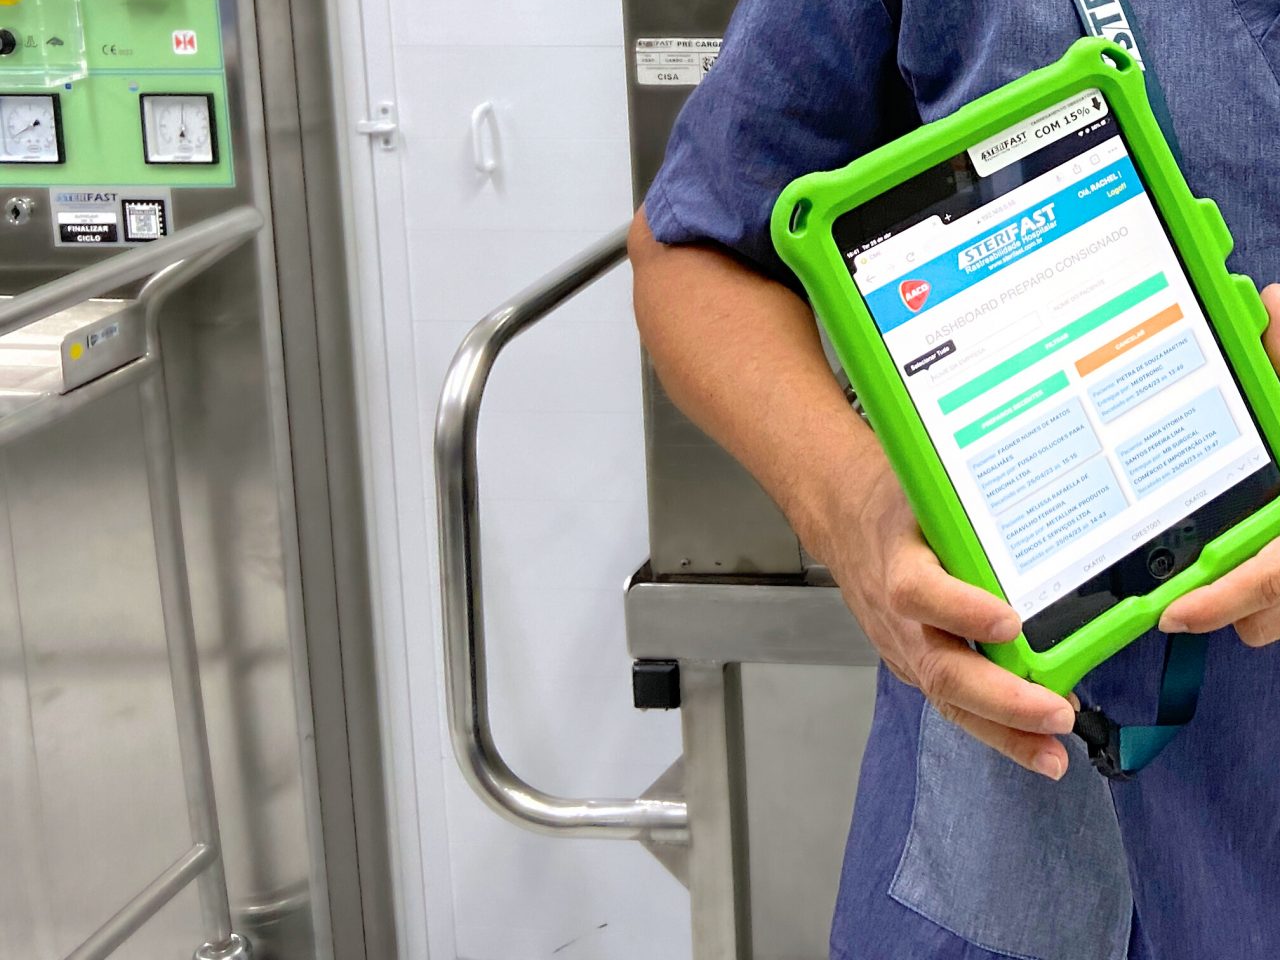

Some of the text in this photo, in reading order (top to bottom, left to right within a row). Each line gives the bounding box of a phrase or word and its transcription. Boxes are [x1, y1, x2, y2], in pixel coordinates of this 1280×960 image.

[657, 73, 679, 81] CISA
[1034, 105, 1090, 139] COM 15%
[1090, 172, 1117, 191] RACHEL
[1106, 182, 1127, 198] Logoff
[67, 224, 109, 233] FINALIZAR
[77, 234, 101, 242] CICLO
[958, 202, 1056, 271] STERIFAST
[965, 219, 1057, 274] Rastreabilidade Hospitalar
[904, 283, 929, 301] AACD
[925, 225, 1129, 345] DASHBOARD PREPARO CONSIGNADO
[1115, 329, 1144, 350] CANCELAR
[1116, 369, 1135, 383] PIETRA
[1144, 353, 1162, 366] SOUZA
[1163, 337, 1187, 354] MARTINS
[1131, 364, 1162, 386] MEDTRONIC
[998, 438, 1020, 454] FAGNER
[1021, 425, 1040, 440] NUNES
[1050, 408, 1069, 422] MATOS
[1069, 423, 1083, 435] PARA
[1144, 406, 1195, 442] MARIA VITORIA DOS
[1125, 425, 1183, 466] SANTOS PEREIRA LIMA
[1172, 429, 1198, 448] SURGICAL
[977, 454, 1013, 478] MAGALHÃES
[1134, 463, 1163, 485] COMÉRCIO
[1167, 438, 1202, 463] IMPORTAÇÃO
[1202, 428, 1216, 441] LTDA
[987, 468, 1030, 498] MEDICINA LTDA
[1026, 496, 1050, 515] MELISSA
[1052, 478, 1079, 499] RAFAELLA
[1046, 485, 1108, 527] METALLINK PRODUTOS
[1184, 488, 1207, 507] CKAT02
[1007, 500, 1065, 539] CARAVLHO FERREIRA
[1131, 518, 1160, 542] CREST001
[1016, 539, 1042, 560] MÉDICOS
[1047, 518, 1075, 539] SERVIÇOS
[1076, 508, 1090, 521] LTDA
[1083, 554, 1105, 572] CKAT01
